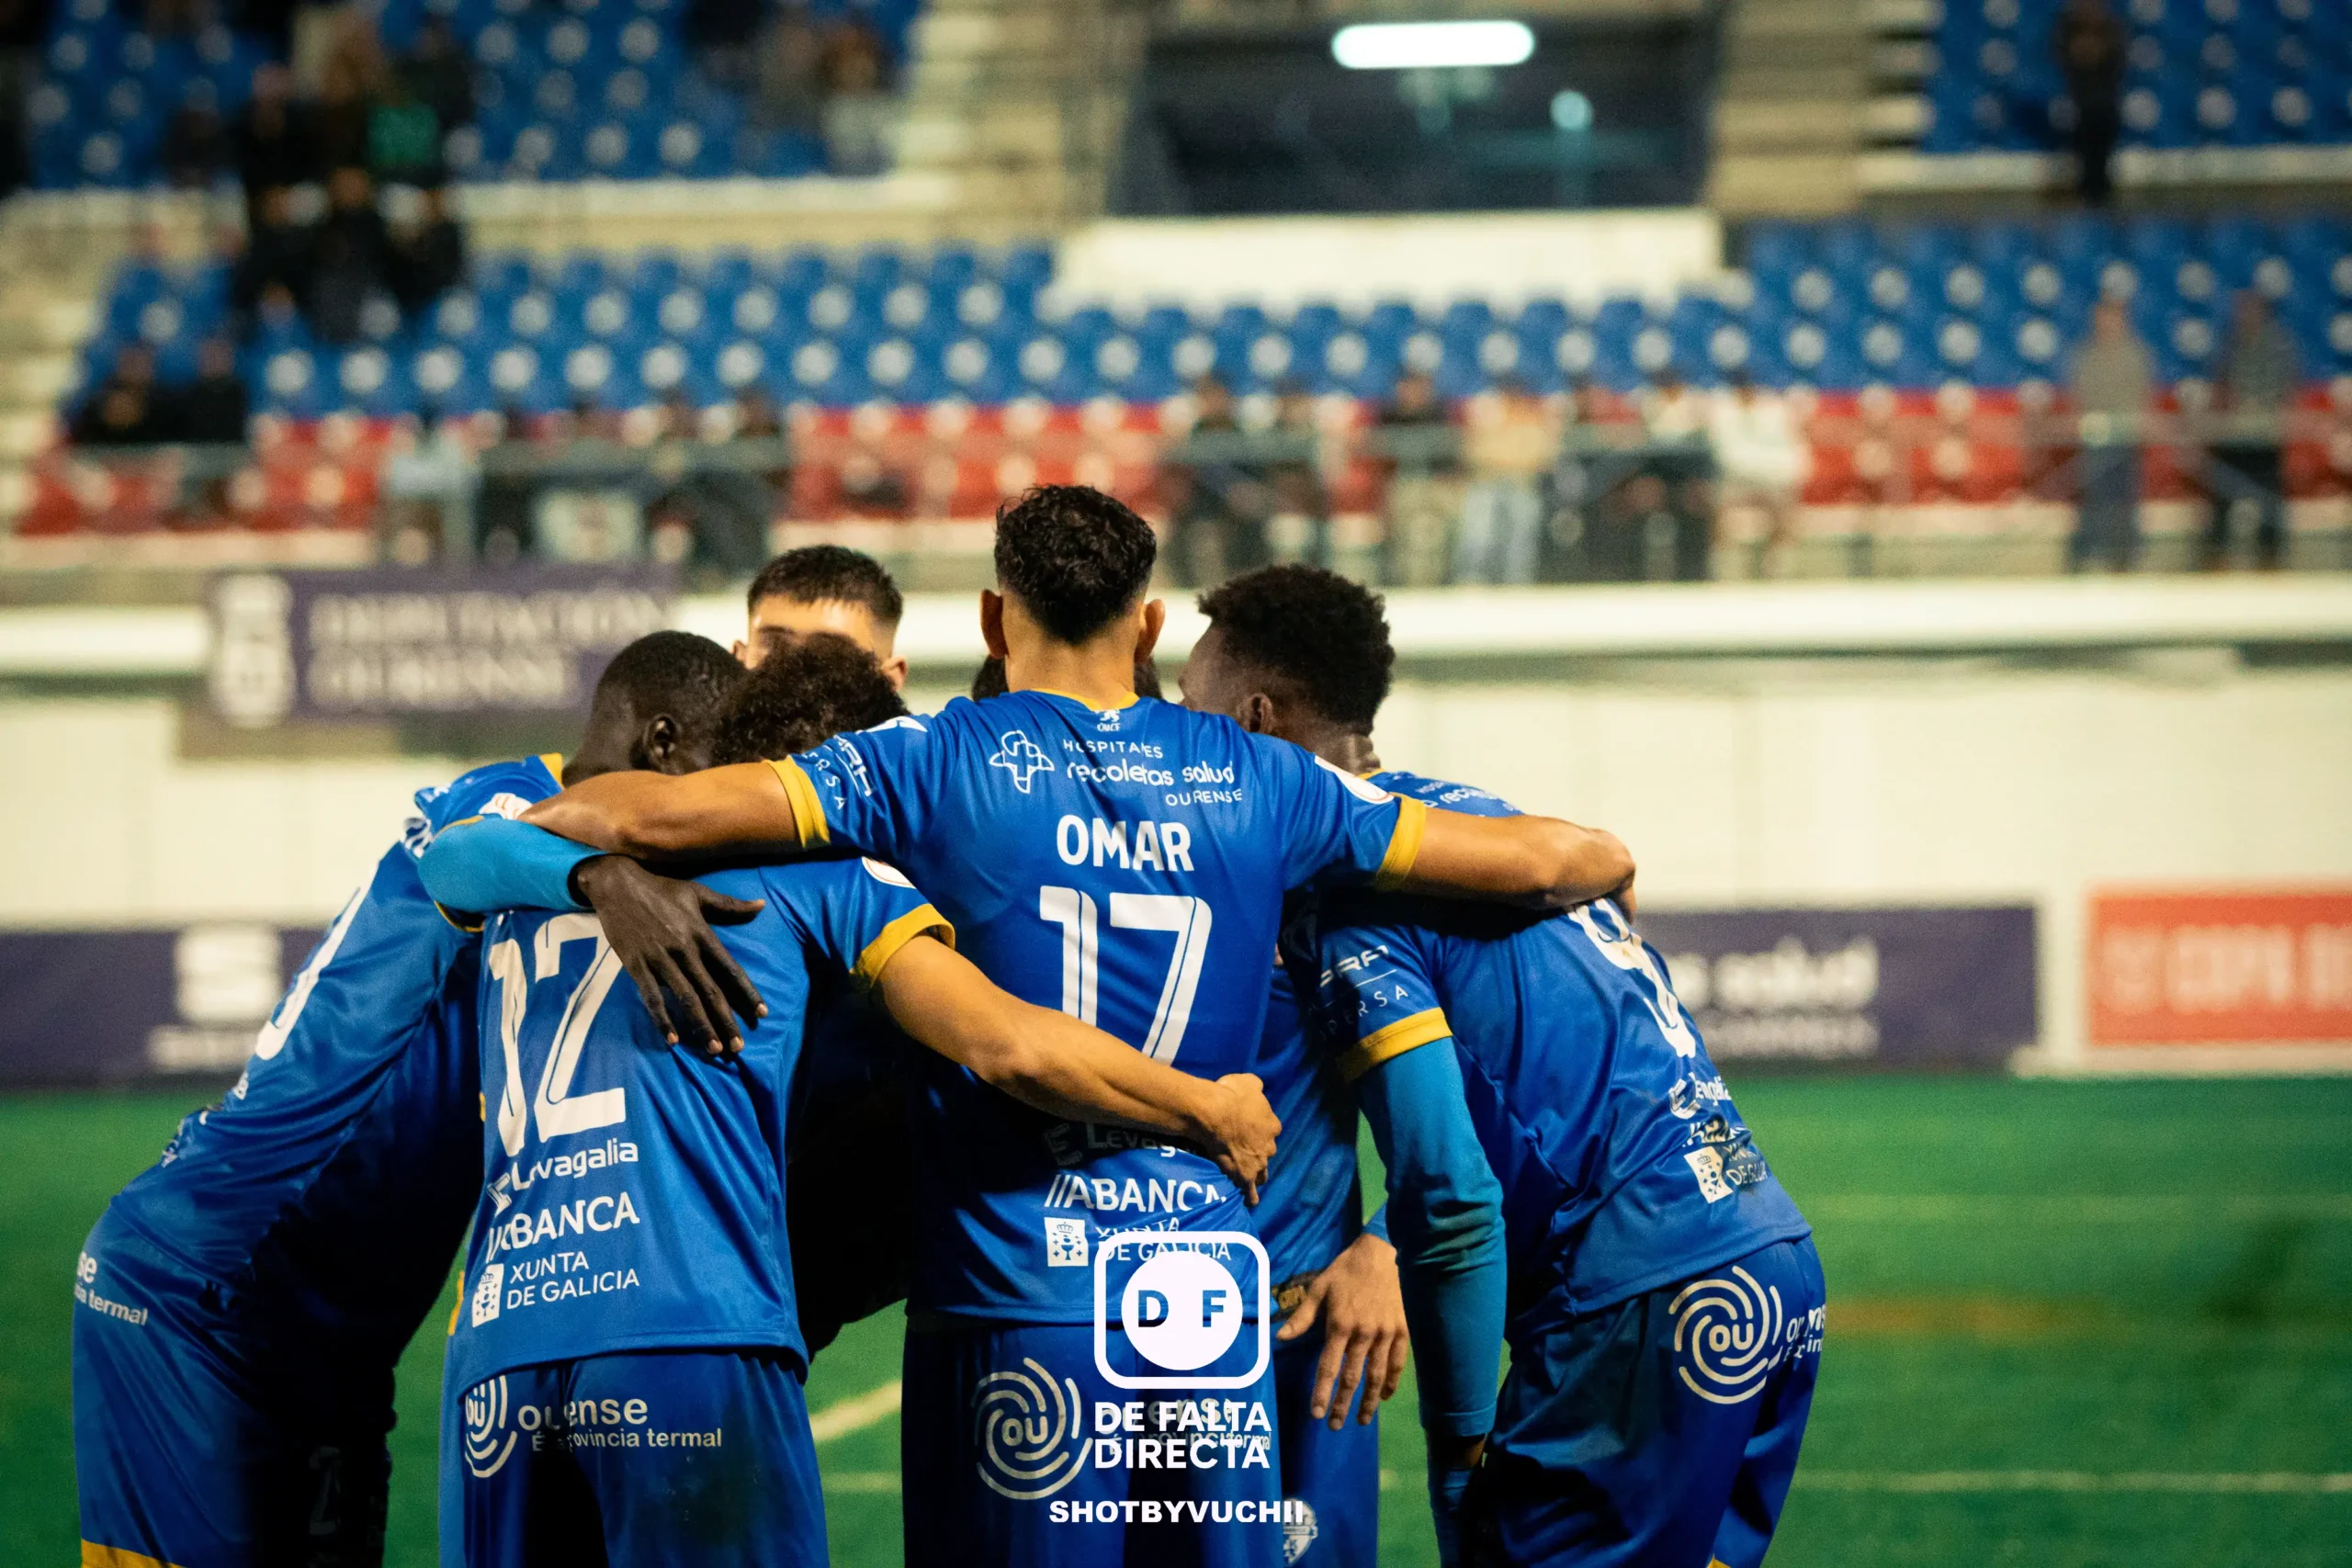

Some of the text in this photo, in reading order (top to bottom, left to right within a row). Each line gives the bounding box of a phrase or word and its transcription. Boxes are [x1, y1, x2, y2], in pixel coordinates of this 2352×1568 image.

[1182, 760, 1235, 784] salud
[1165, 788, 1243, 807] OURENSE
[1056, 815, 1194, 873] OMAR
[1039, 884, 1213, 1066] 17
[488, 912, 628, 1158] 12
[509, 1250, 590, 1284] XUNTA
[506, 1268, 640, 1310] DE GALICIA
[647, 1427, 722, 1449] termal
